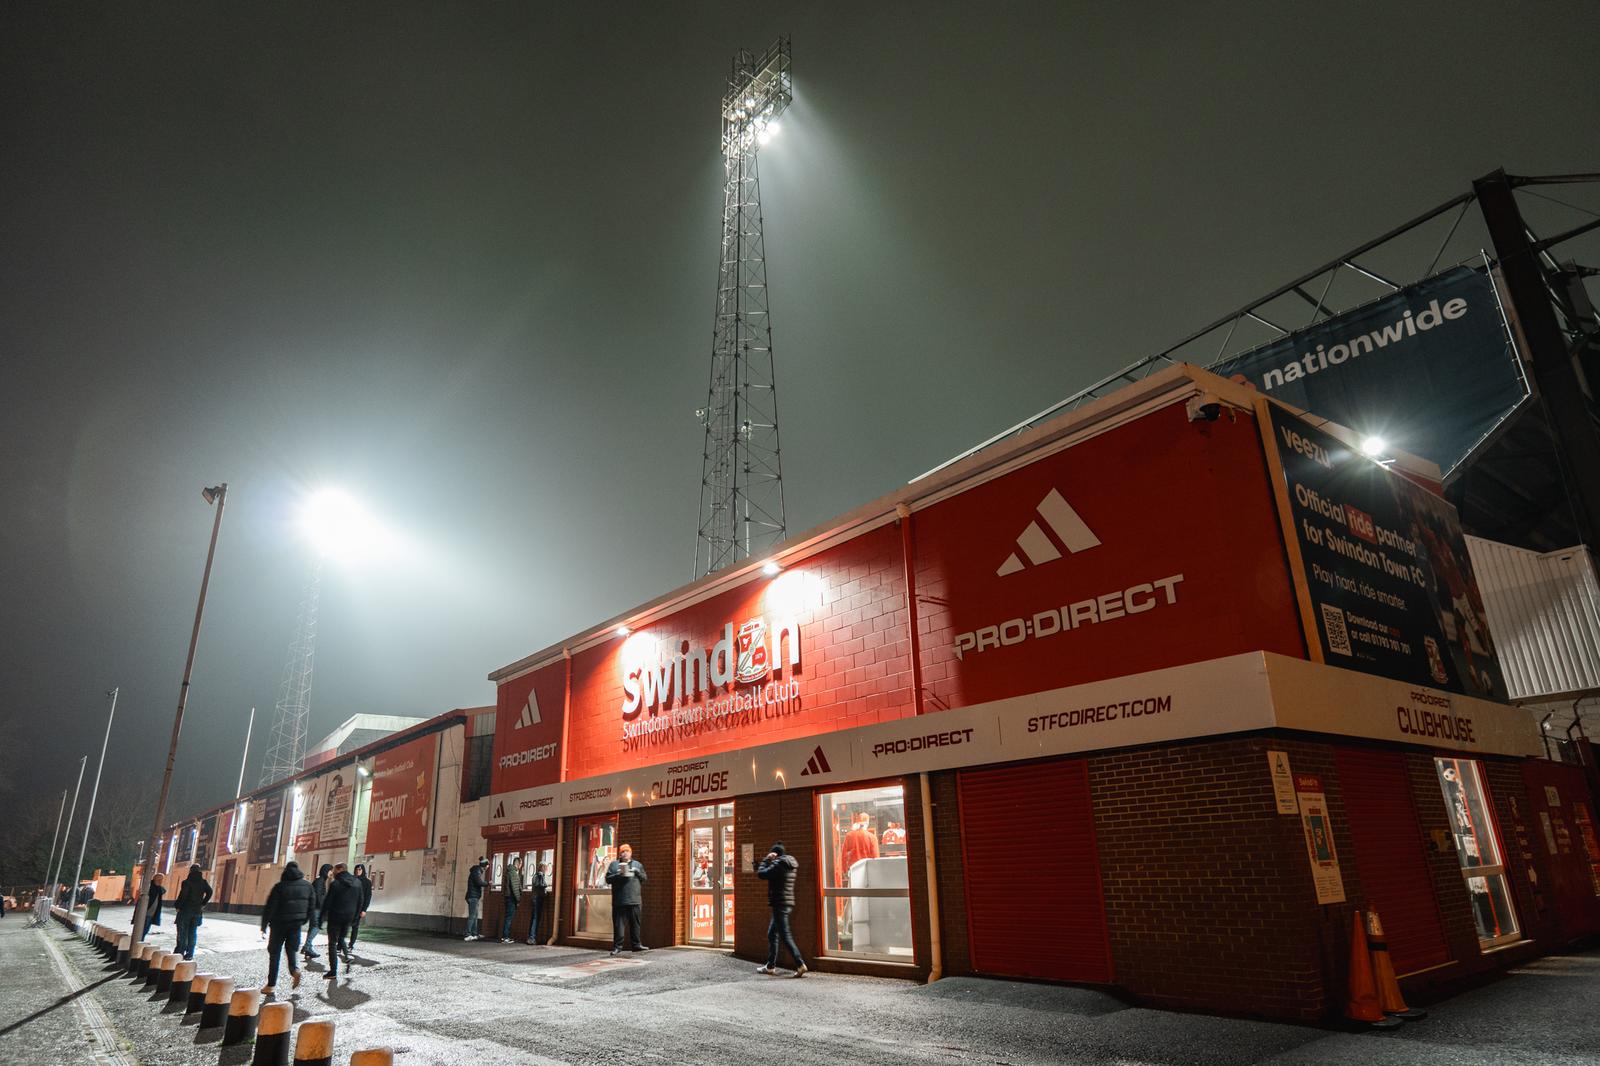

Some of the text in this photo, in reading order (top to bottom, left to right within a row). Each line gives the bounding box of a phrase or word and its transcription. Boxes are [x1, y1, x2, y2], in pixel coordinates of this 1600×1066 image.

[1262, 297, 1468, 390] nationwide
[1295, 483, 1417, 557] Official ride partner
[1303, 518, 1426, 588] for Swindon Town FC
[1312, 563, 1334, 589] Play
[952, 573, 1184, 662] PRO:DIRECT
[623, 676, 800, 739] Swindon Town Football Club
[1027, 695, 1172, 733] STFCDIRECT.COM
[1397, 706, 1476, 743] CLUBHOUSE
[872, 728, 974, 758] PRO:DIRECT
[651, 770, 729, 799] CLUBHOUSE
[370, 793, 408, 823] MIPERMIT
